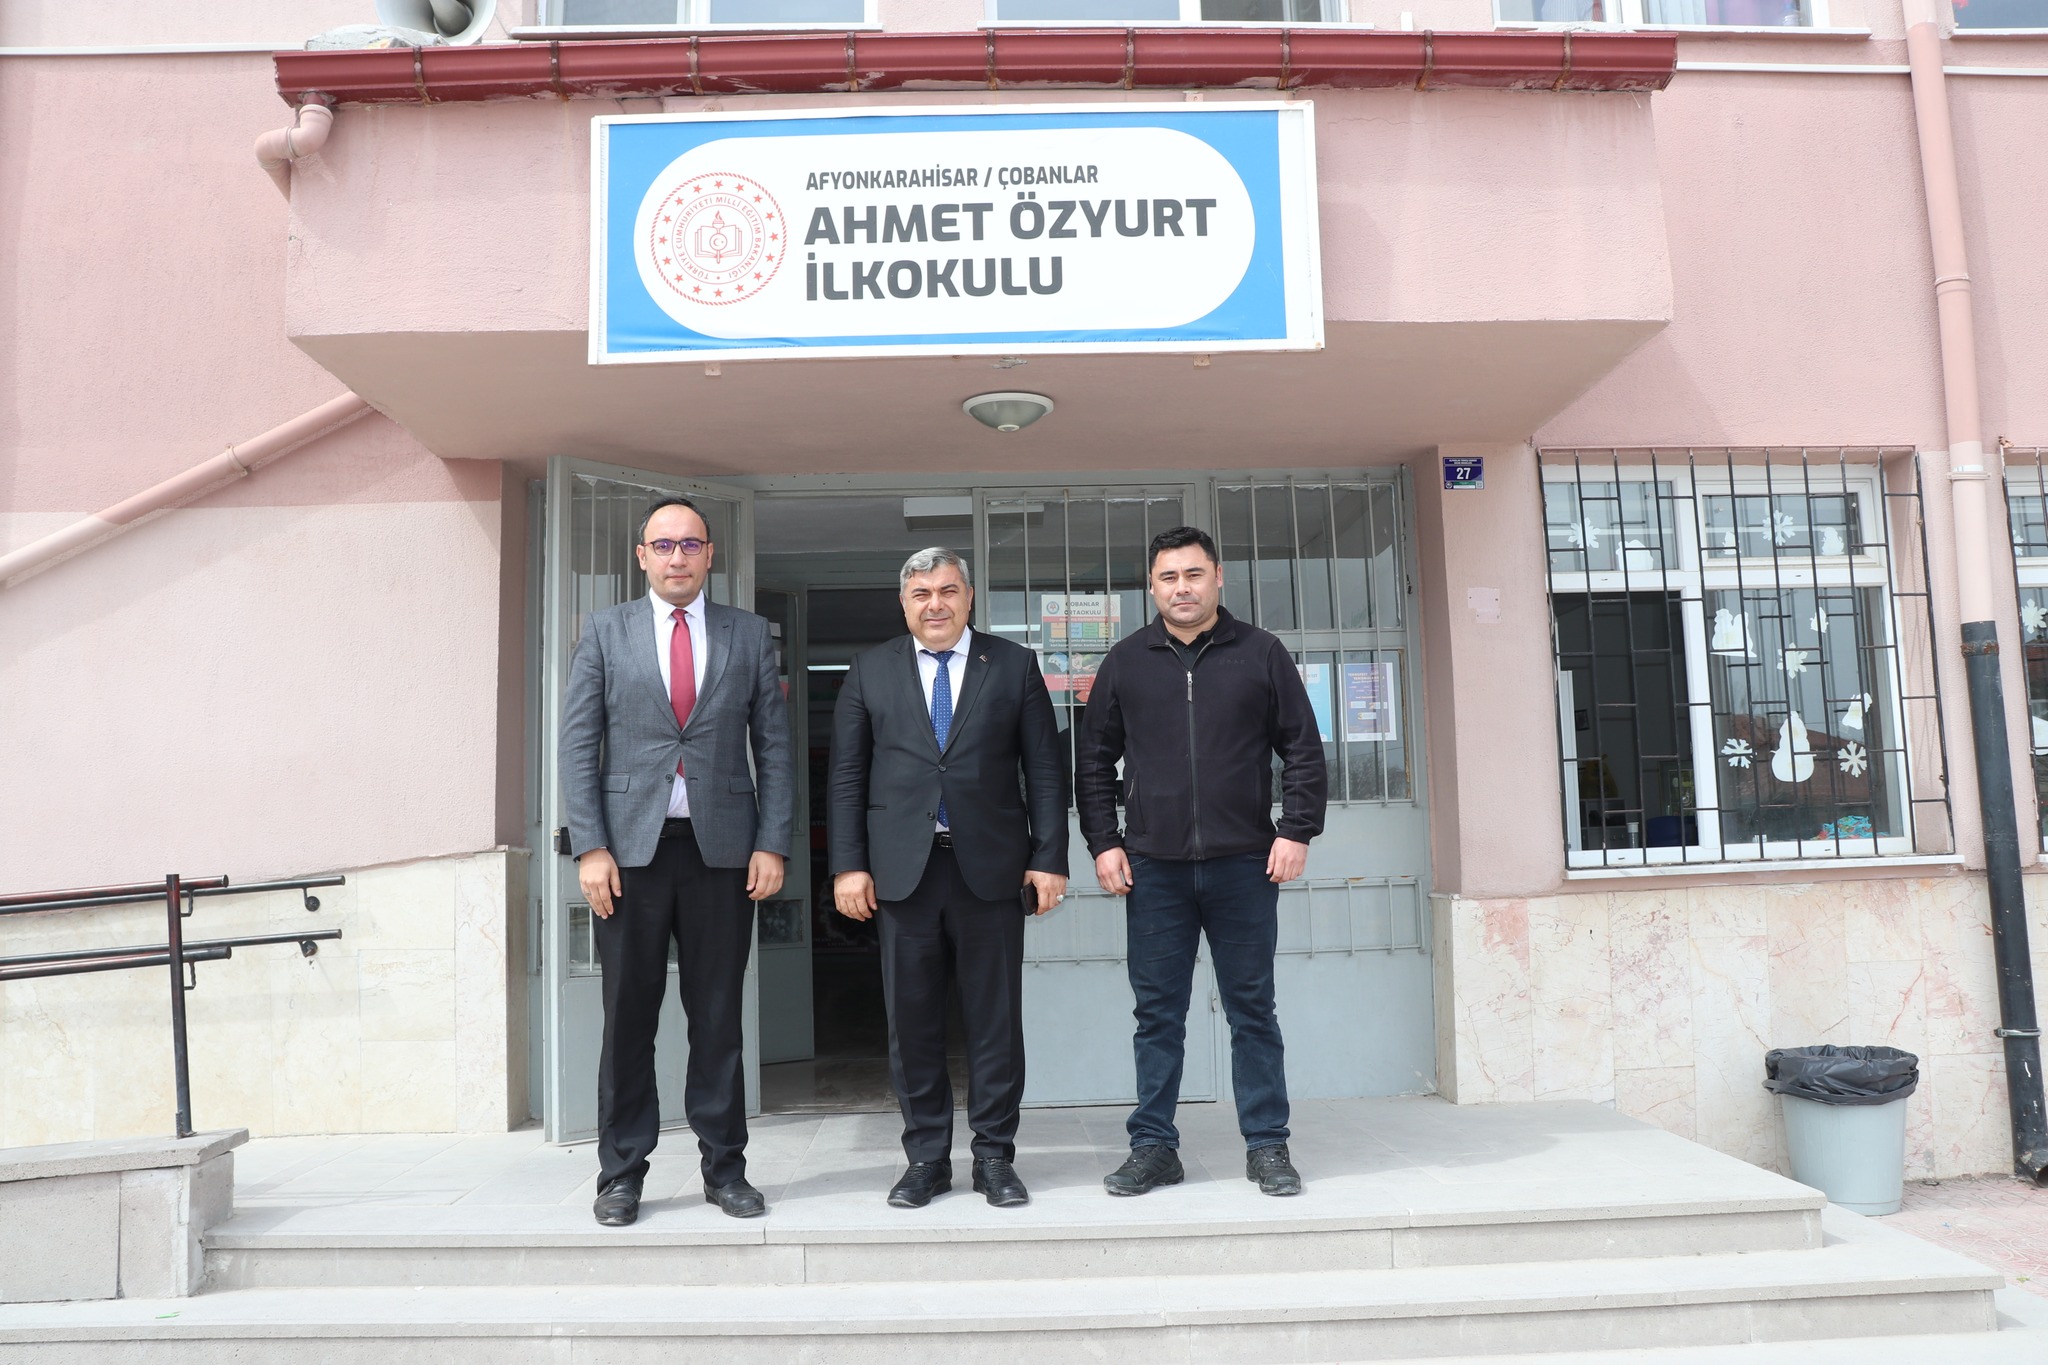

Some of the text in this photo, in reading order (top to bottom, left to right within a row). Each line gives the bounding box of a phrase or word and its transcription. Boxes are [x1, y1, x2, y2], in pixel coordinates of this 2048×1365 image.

[805, 163, 1099, 191] AFYONKARAHİSAR / ÇOBANLAR
[715, 196, 742, 208] MİLLİ
[741, 205, 761, 234] EĞİTİM
[804, 191, 1217, 245] AHMET ÖZYURT
[728, 237, 762, 279] BAKANLIĞI
[805, 252, 1063, 301] İLKOKULU
[1456, 467, 1471, 480] 27
